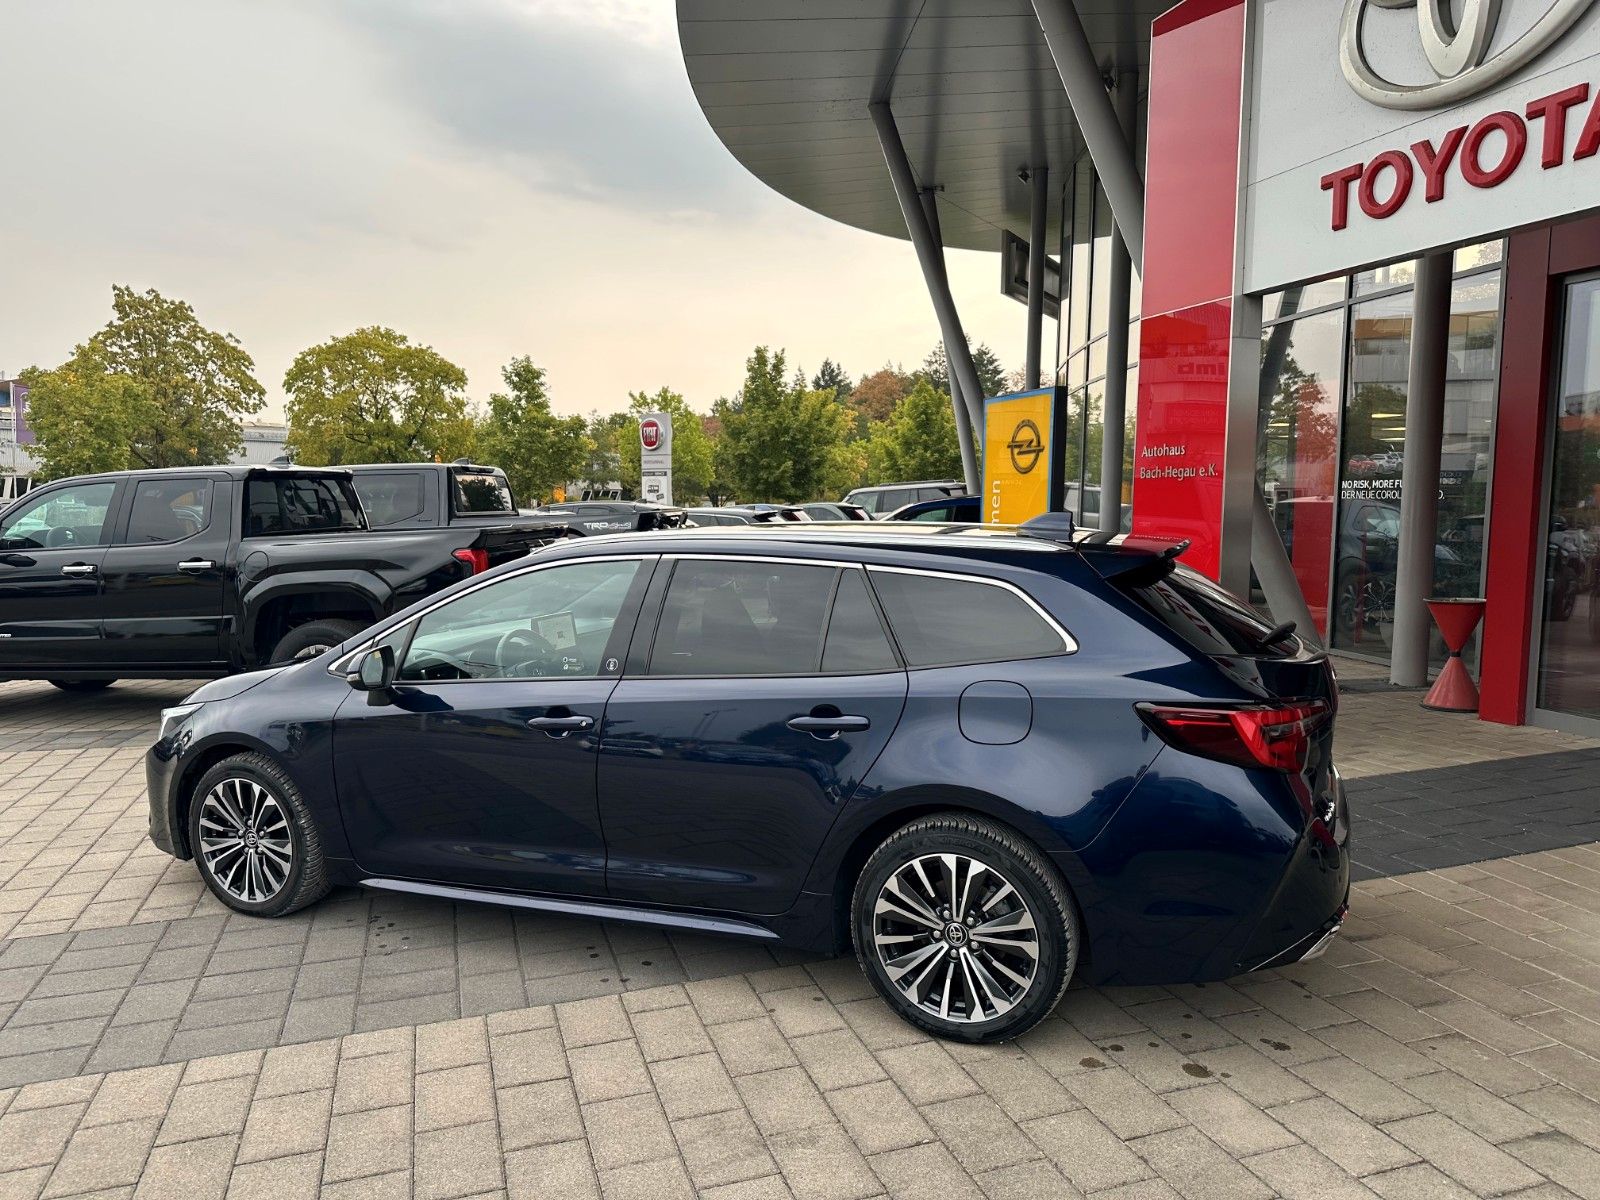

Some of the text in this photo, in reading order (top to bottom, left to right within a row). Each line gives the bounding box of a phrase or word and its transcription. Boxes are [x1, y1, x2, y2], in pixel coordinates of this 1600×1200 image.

[1141, 444, 1186, 458] Autohaus
[1139, 463, 1219, 481] Bach-Hegau e.K.
[1342, 480, 1352, 489] NO
[1353, 480, 1372, 490] RISK,
[1372, 479, 1394, 489] MORE
[1341, 490, 1356, 499] DER
[1356, 490, 1376, 499] NEUE
[583, 522, 608, 530] TRD
